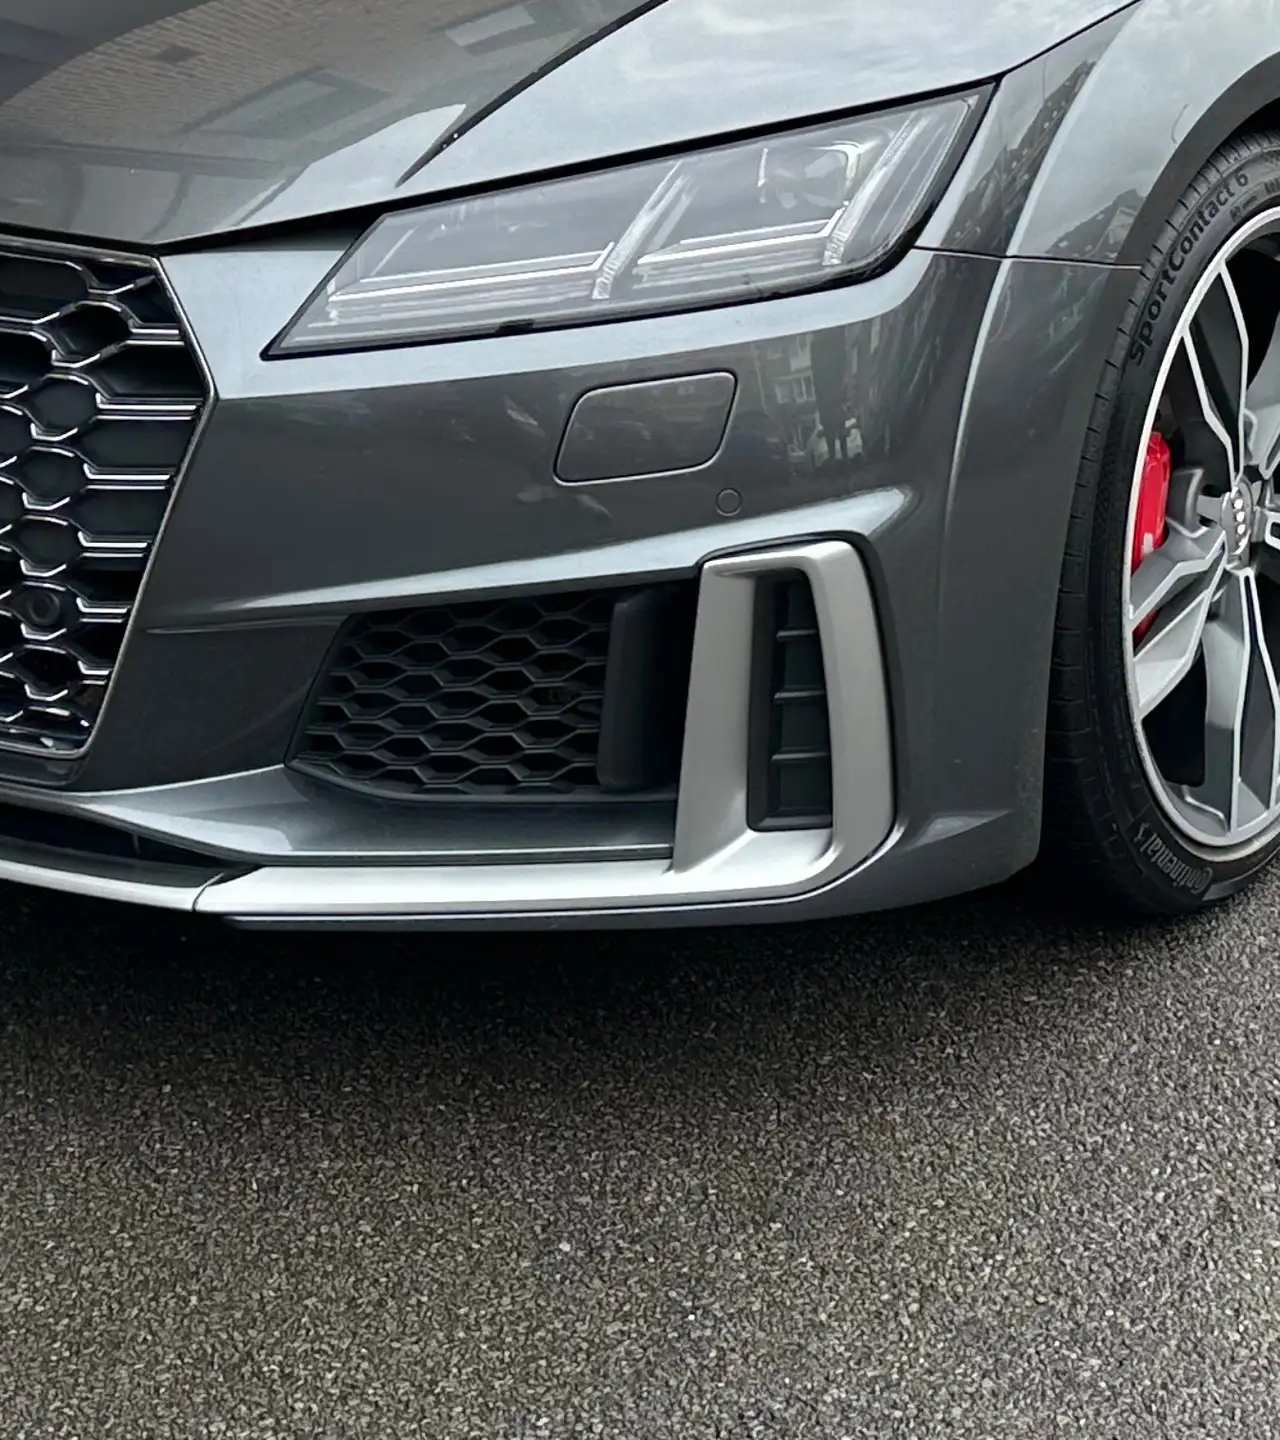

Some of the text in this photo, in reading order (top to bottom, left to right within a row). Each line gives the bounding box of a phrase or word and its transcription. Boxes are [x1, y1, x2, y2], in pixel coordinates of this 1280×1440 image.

[1129, 172, 1250, 366] SportContact 6
[1139, 832, 1213, 895] Continental
